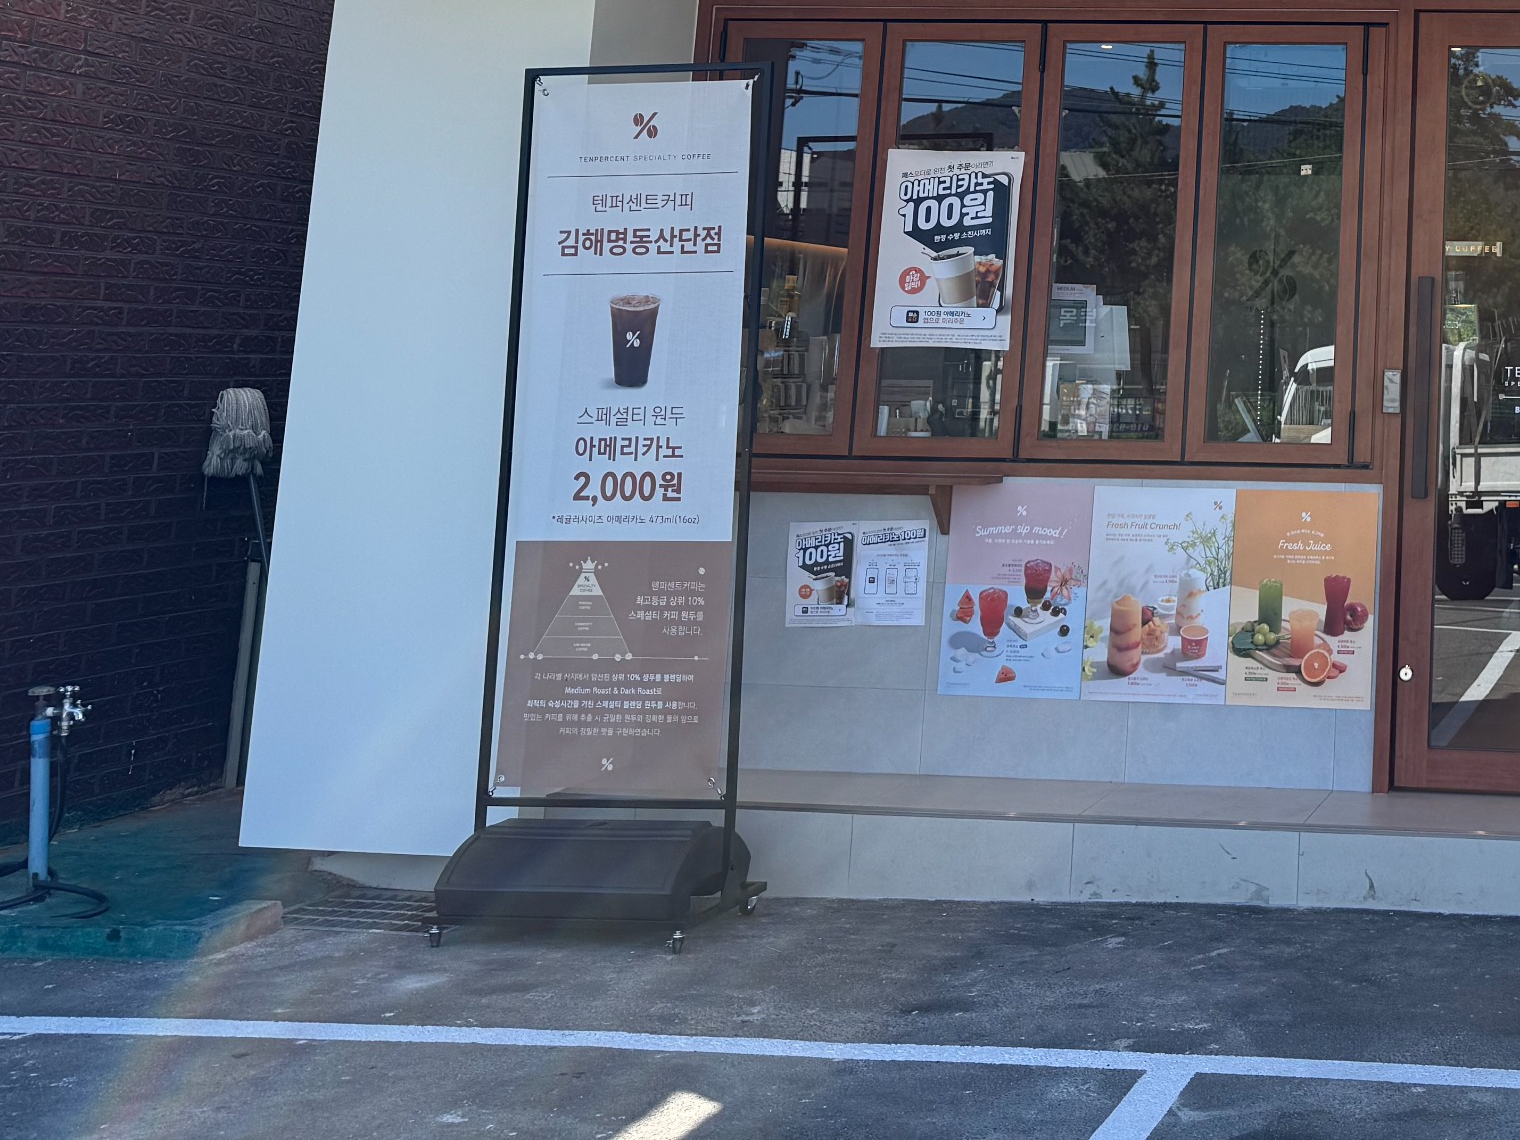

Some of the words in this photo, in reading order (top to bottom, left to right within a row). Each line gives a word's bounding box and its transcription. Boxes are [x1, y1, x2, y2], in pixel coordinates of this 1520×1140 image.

[947, 165, 955, 173] 첫
[900, 171, 994, 200] 아메리카노
[592, 192, 694, 212] 텐퍼센트커피
[899, 191, 993, 232] 100원
[557, 225, 722, 256] 김해명동산단점
[577, 406, 646, 427] 스페셜티
[651, 406, 685, 426] 원두
[575, 436, 683, 461] 아메리카노
[573, 471, 682, 506] 2,000원
[607, 515, 646, 524] 아메리카노
[1107, 521, 1128, 529] Fresh
[1150, 522, 1181, 530] Crunch!
[861, 532, 899, 545] 아메리카노
[900, 528, 926, 541] 100원
[976, 525, 1015, 536] Summer
[1017, 524, 1030, 536] sip
[796, 532, 844, 549] 아메리카노
[1278, 540, 1304, 550] Fresh
[1306, 541, 1332, 550] Juice
[795, 542, 844, 566] 100원
[636, 596, 666, 605] 최고등급
[669, 596, 685, 605] 상위
[688, 597, 705, 605] 10%
[663, 611, 678, 620] 커피
[627, 673, 640, 681] 10%
[565, 687, 591, 695] Medium
[593, 687, 611, 695] Roast
[613, 687, 618, 695] &
[620, 687, 635, 695] Dark
